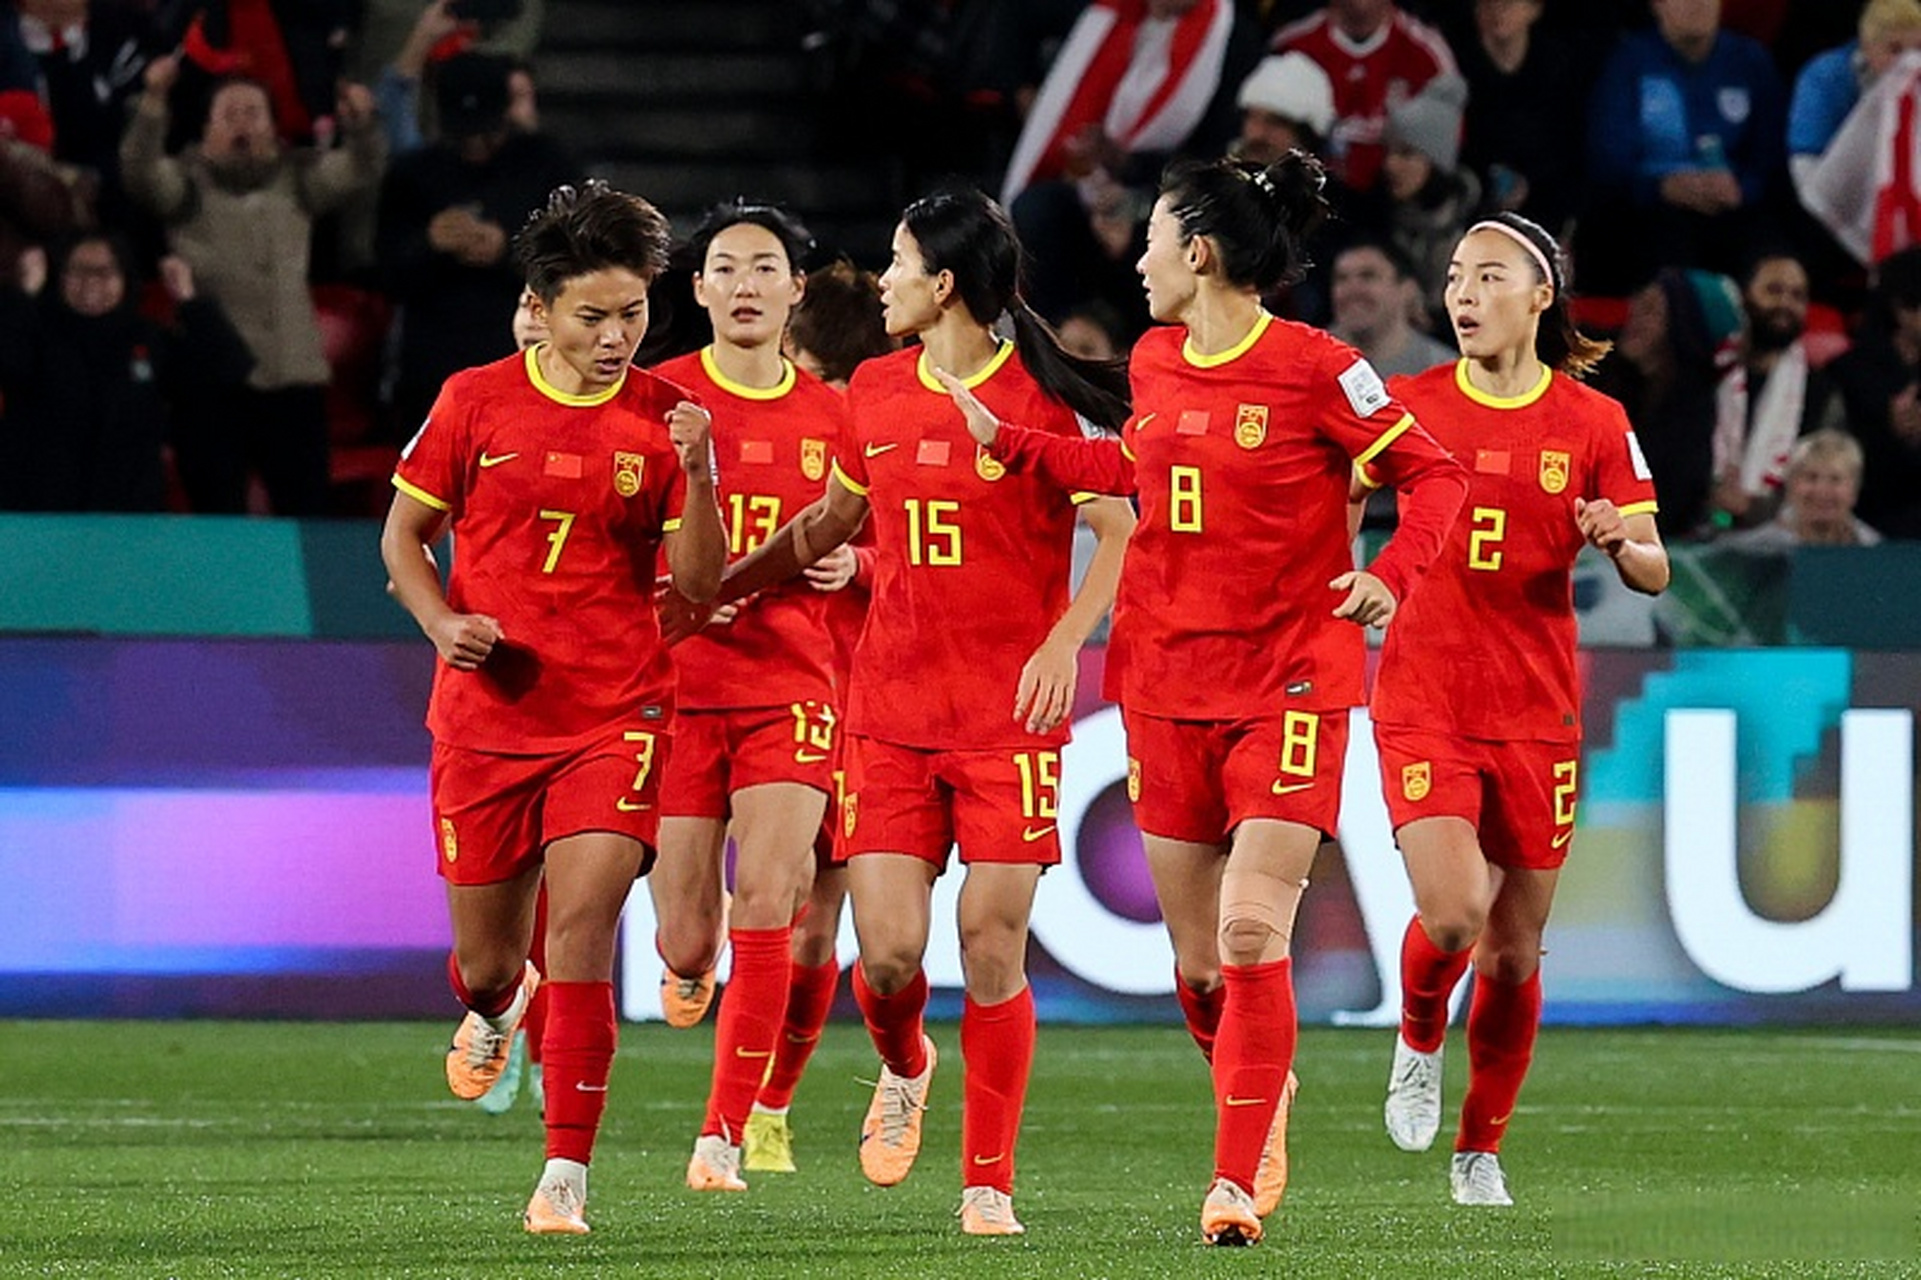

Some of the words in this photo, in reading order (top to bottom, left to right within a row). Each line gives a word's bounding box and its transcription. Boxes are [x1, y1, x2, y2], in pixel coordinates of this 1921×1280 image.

[730, 494, 782, 553] 13
[905, 499, 962, 566] 15
[1170, 466, 1203, 533] 8
[540, 510, 574, 574] 7
[1469, 508, 1506, 571] 2
[623, 732, 655, 793] 7
[1280, 710, 1319, 776] 8
[1013, 752, 1059, 818] 15
[1553, 760, 1577, 826] 2
